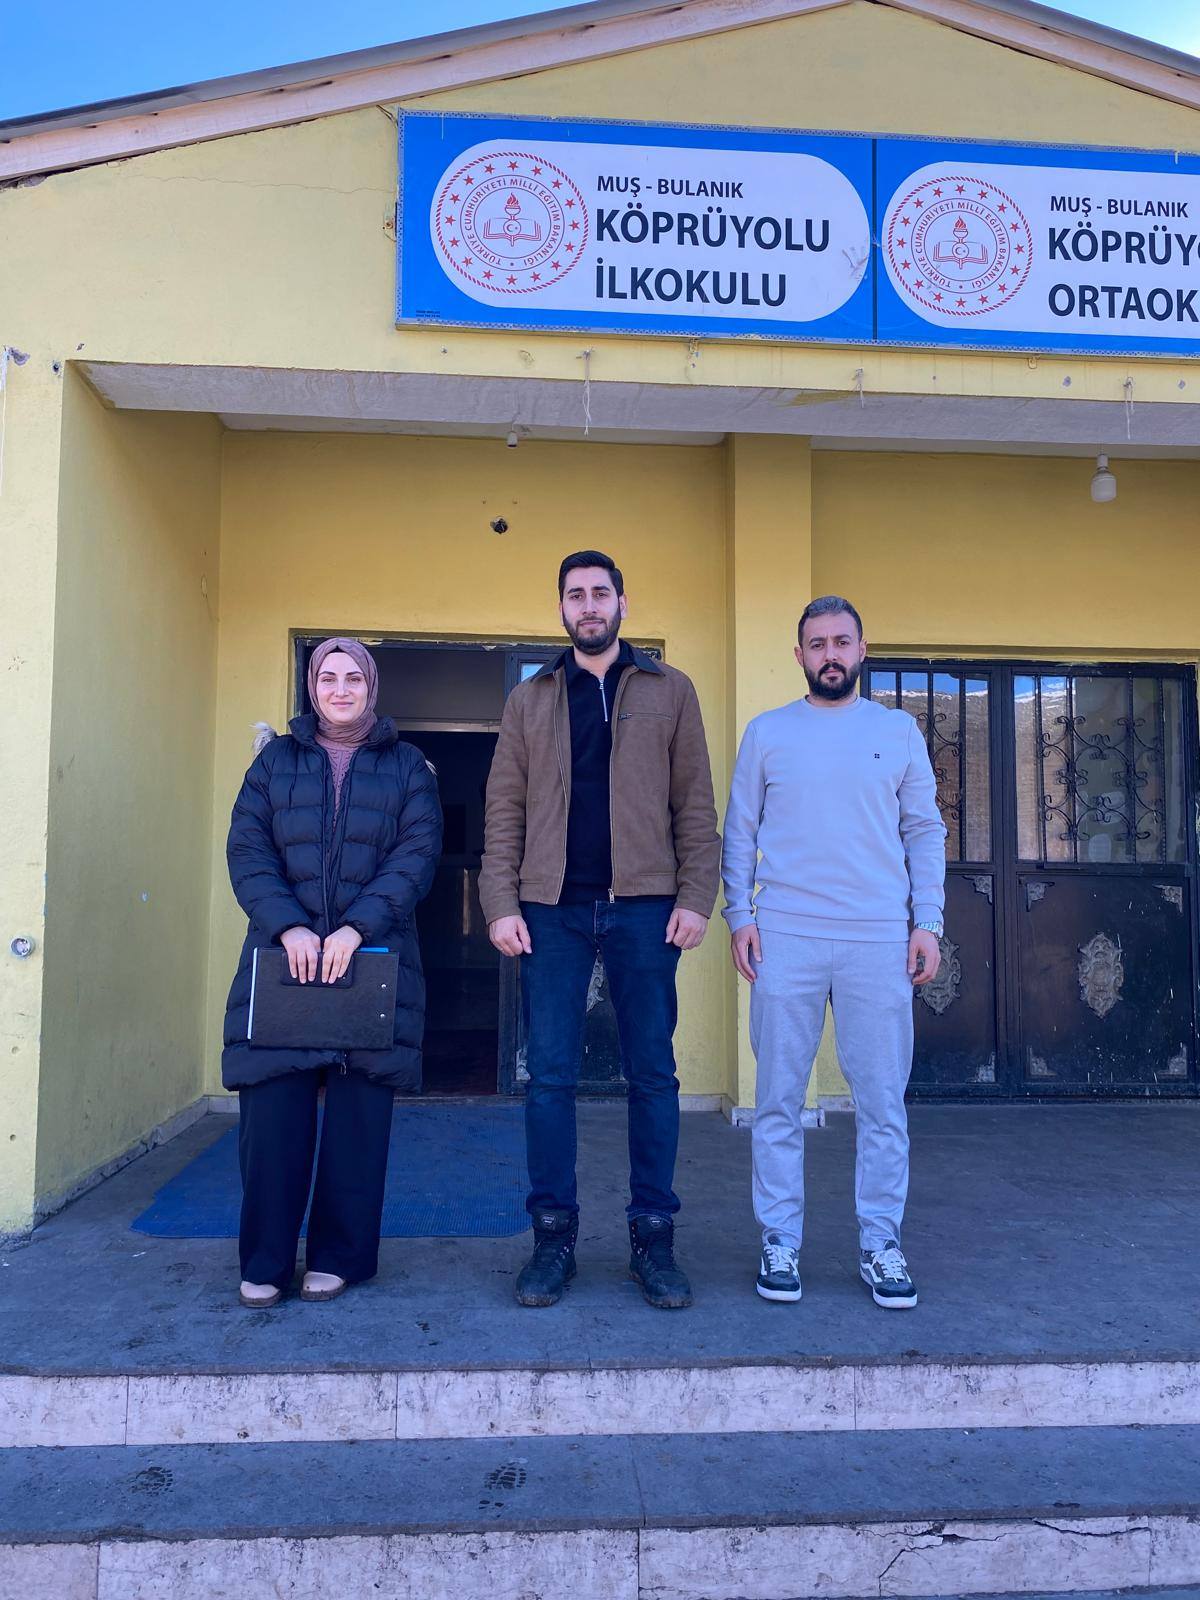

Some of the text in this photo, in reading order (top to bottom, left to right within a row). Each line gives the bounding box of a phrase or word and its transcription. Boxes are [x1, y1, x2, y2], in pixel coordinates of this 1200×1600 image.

[464, 179, 507, 230] CUMHURİYETİ
[539, 190, 561, 222] EĞİTİM
[597, 175, 641, 198] MUŞ
[657, 178, 744, 199] BULANIK
[1050, 195, 1092, 218] MUŞ
[1107, 198, 1189, 218] BULANIK
[523, 224, 561, 266] BAKANLIĞI
[597, 202, 830, 253] KÖPRÜYOLU
[915, 203, 954, 254] CUMHURİYETİ
[985, 213, 1006, 246] EĞİTİM
[1049, 221, 1200, 266] KÖPRÜY
[467, 235, 502, 266] TÜRKİYE
[972, 247, 1006, 288] BAKANLIĞI
[596, 257, 786, 307] İLKOKULU
[918, 257, 951, 288] TÜRKİYE
